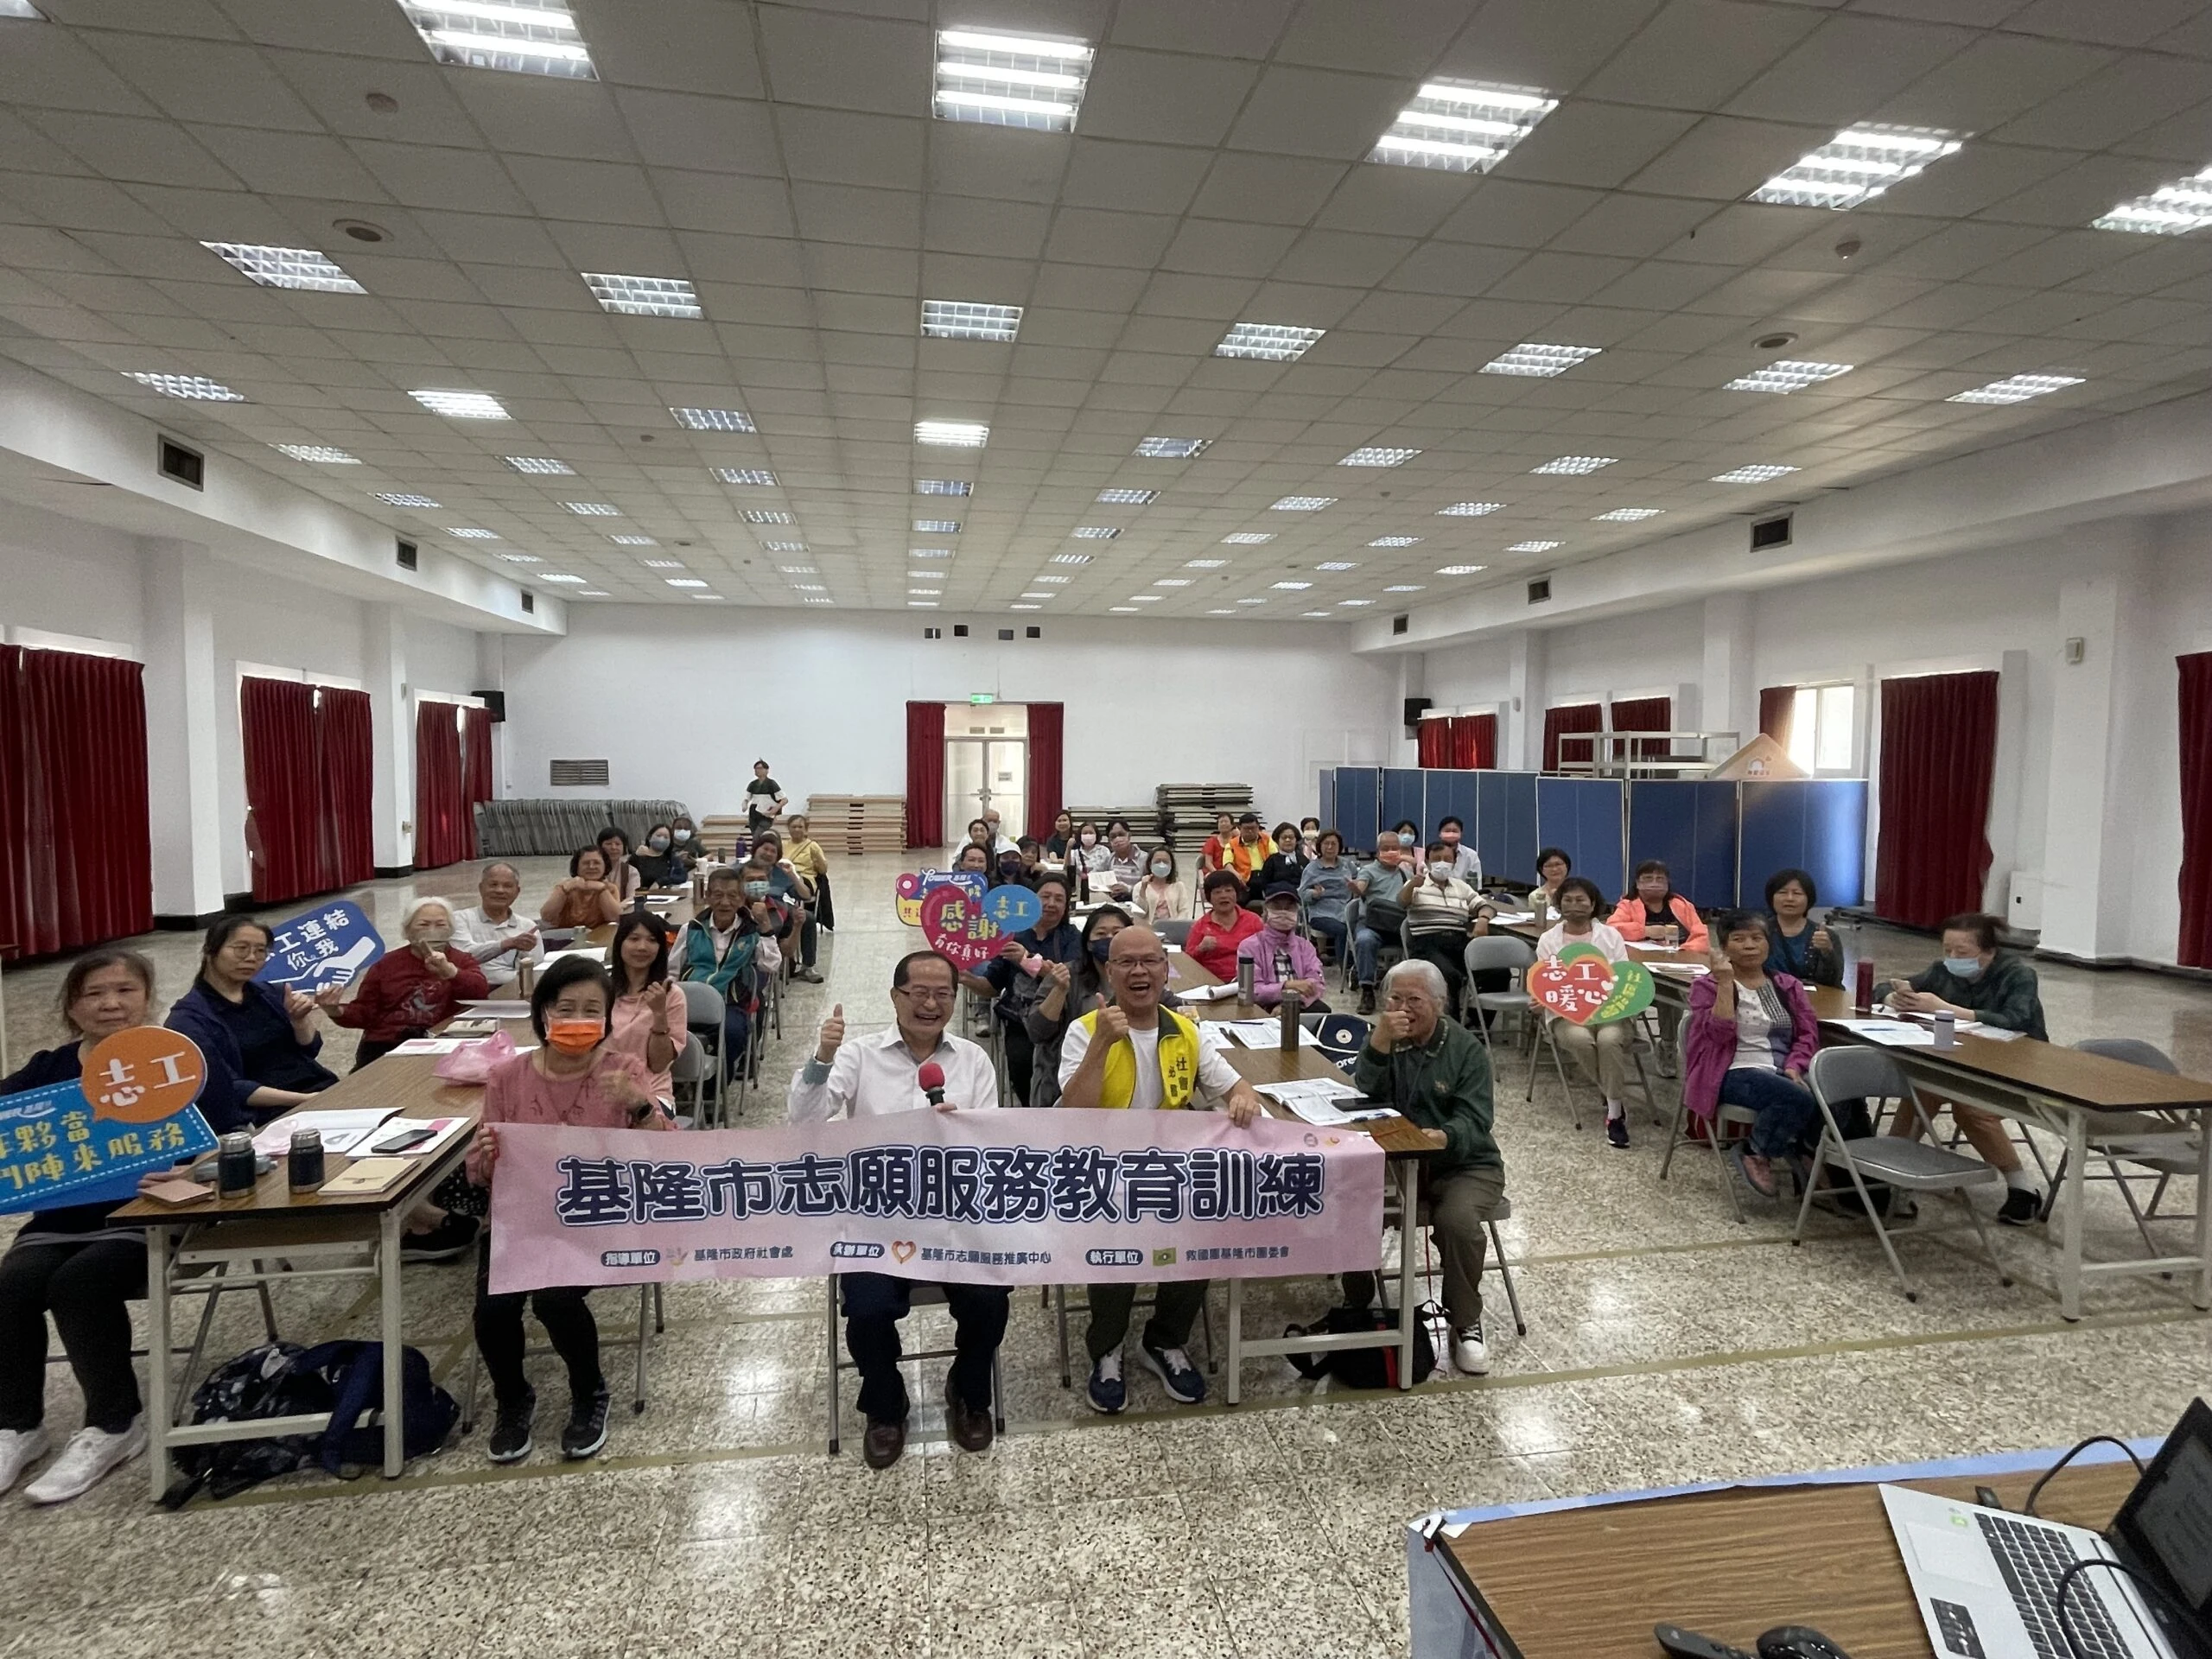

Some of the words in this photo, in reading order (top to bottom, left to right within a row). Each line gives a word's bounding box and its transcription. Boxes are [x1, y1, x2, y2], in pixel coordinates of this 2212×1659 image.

[940, 900, 1000, 940] 感謝
[994, 895, 1029, 919] 志工
[264, 908, 350, 962] 工連結
[1541, 954, 1599, 982] 志工
[1545, 984, 1609, 1012] 暖心
[99, 1051, 196, 1107] 志工
[558, 1145, 1324, 1226] 基隆市志願服務教育訓練
[694, 1245, 793, 1262] 基隆市政府社會處
[921, 1247, 1052, 1266] 基隆市志願服務推廣中心
[1090, 1249, 1139, 1264] 執行單位
